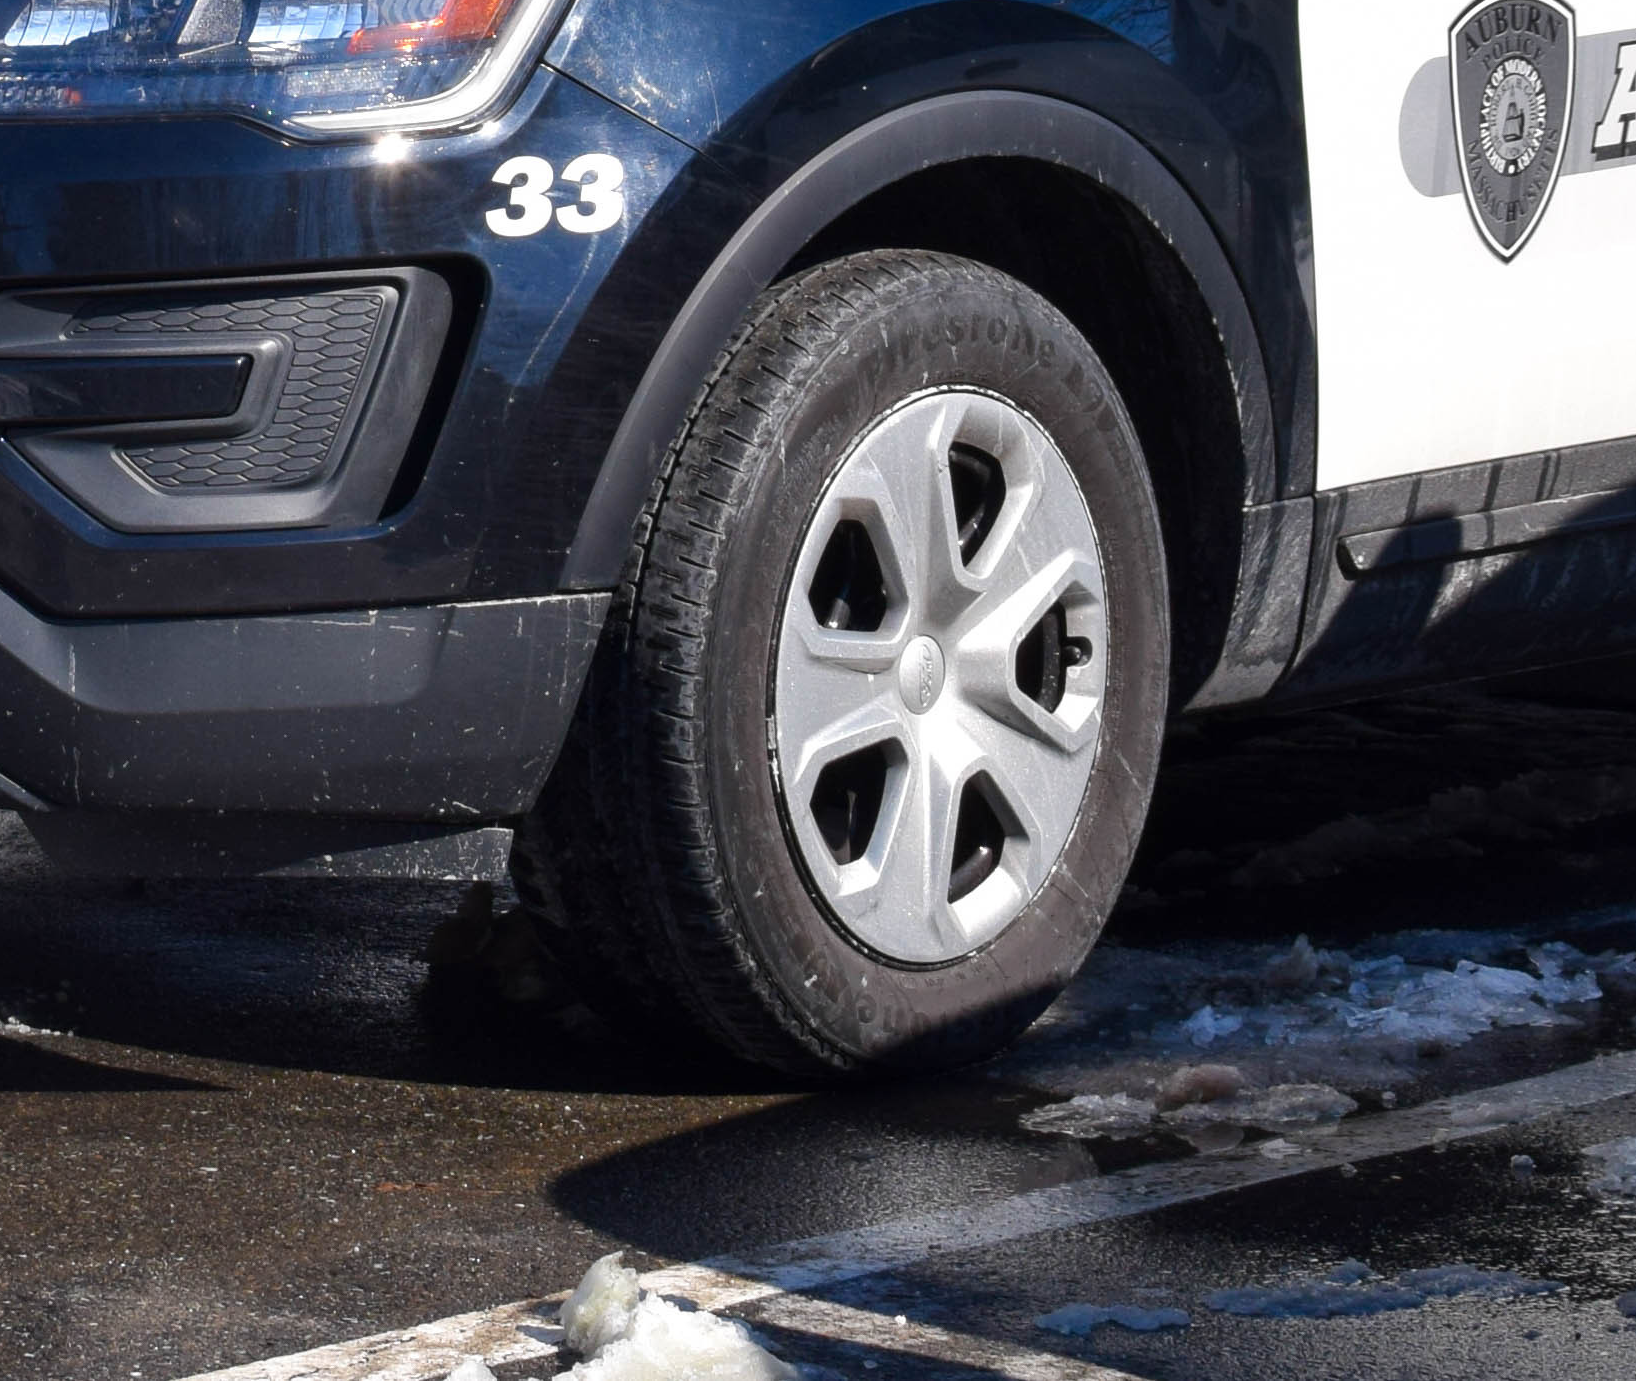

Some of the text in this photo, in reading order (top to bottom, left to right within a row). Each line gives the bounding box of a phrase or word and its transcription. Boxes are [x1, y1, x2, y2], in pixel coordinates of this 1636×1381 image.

[1463, 2, 1563, 62] AUBURN
[1482, 37, 1547, 71] POLICE
[484, 153, 627, 237] 33
